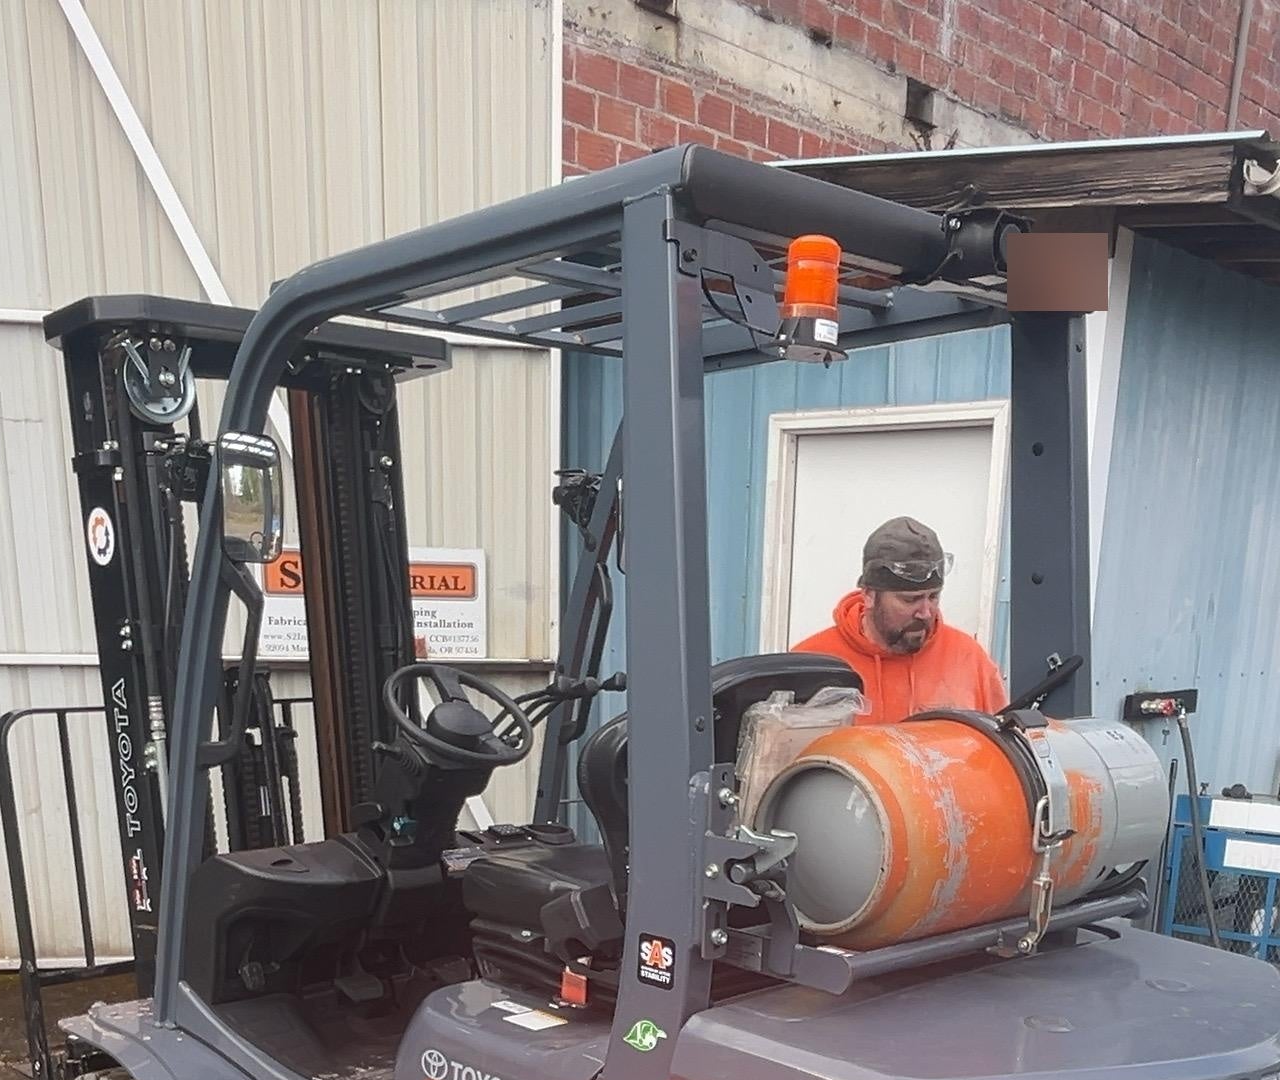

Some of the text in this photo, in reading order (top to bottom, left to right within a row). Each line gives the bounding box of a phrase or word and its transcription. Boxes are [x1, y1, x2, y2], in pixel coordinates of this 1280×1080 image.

[411, 575, 466, 591] RIAL
[111, 678, 142, 837] TOYOTA
[640, 940, 673, 969] SAS
